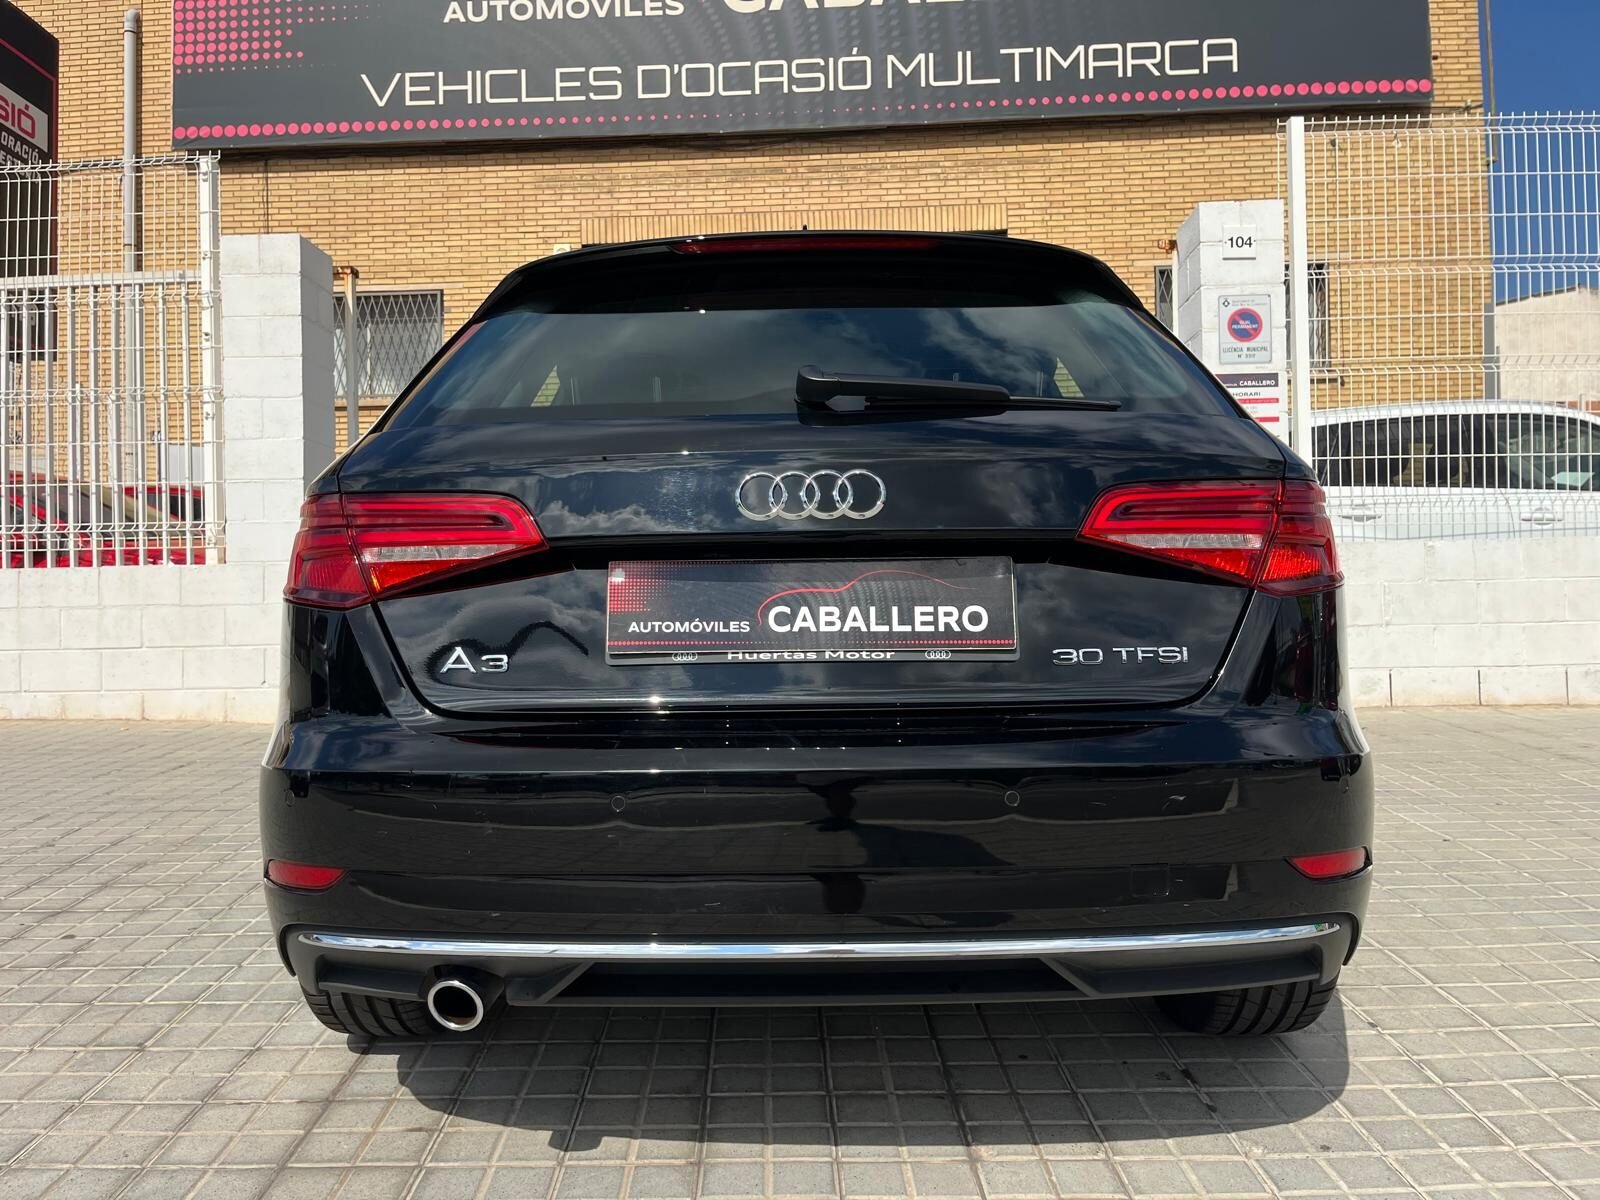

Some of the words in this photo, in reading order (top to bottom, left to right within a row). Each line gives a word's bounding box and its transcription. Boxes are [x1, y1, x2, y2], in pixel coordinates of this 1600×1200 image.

[360, 66, 622, 107] VEHICLES
[637, 47, 872, 99] D'OCASIÓ
[887, 38, 1238, 88] MULTIMARCA
[1227, 236, 1253, 248] 104
[628, 617, 750, 633] AUTOMÓVILES
[768, 605, 989, 633] CABALLERO
[727, 650, 818, 660] Huertas
[824, 650, 895, 660] Motor
[1052, 648, 1103, 665] 30
[1112, 646, 1188, 664] TFSI
